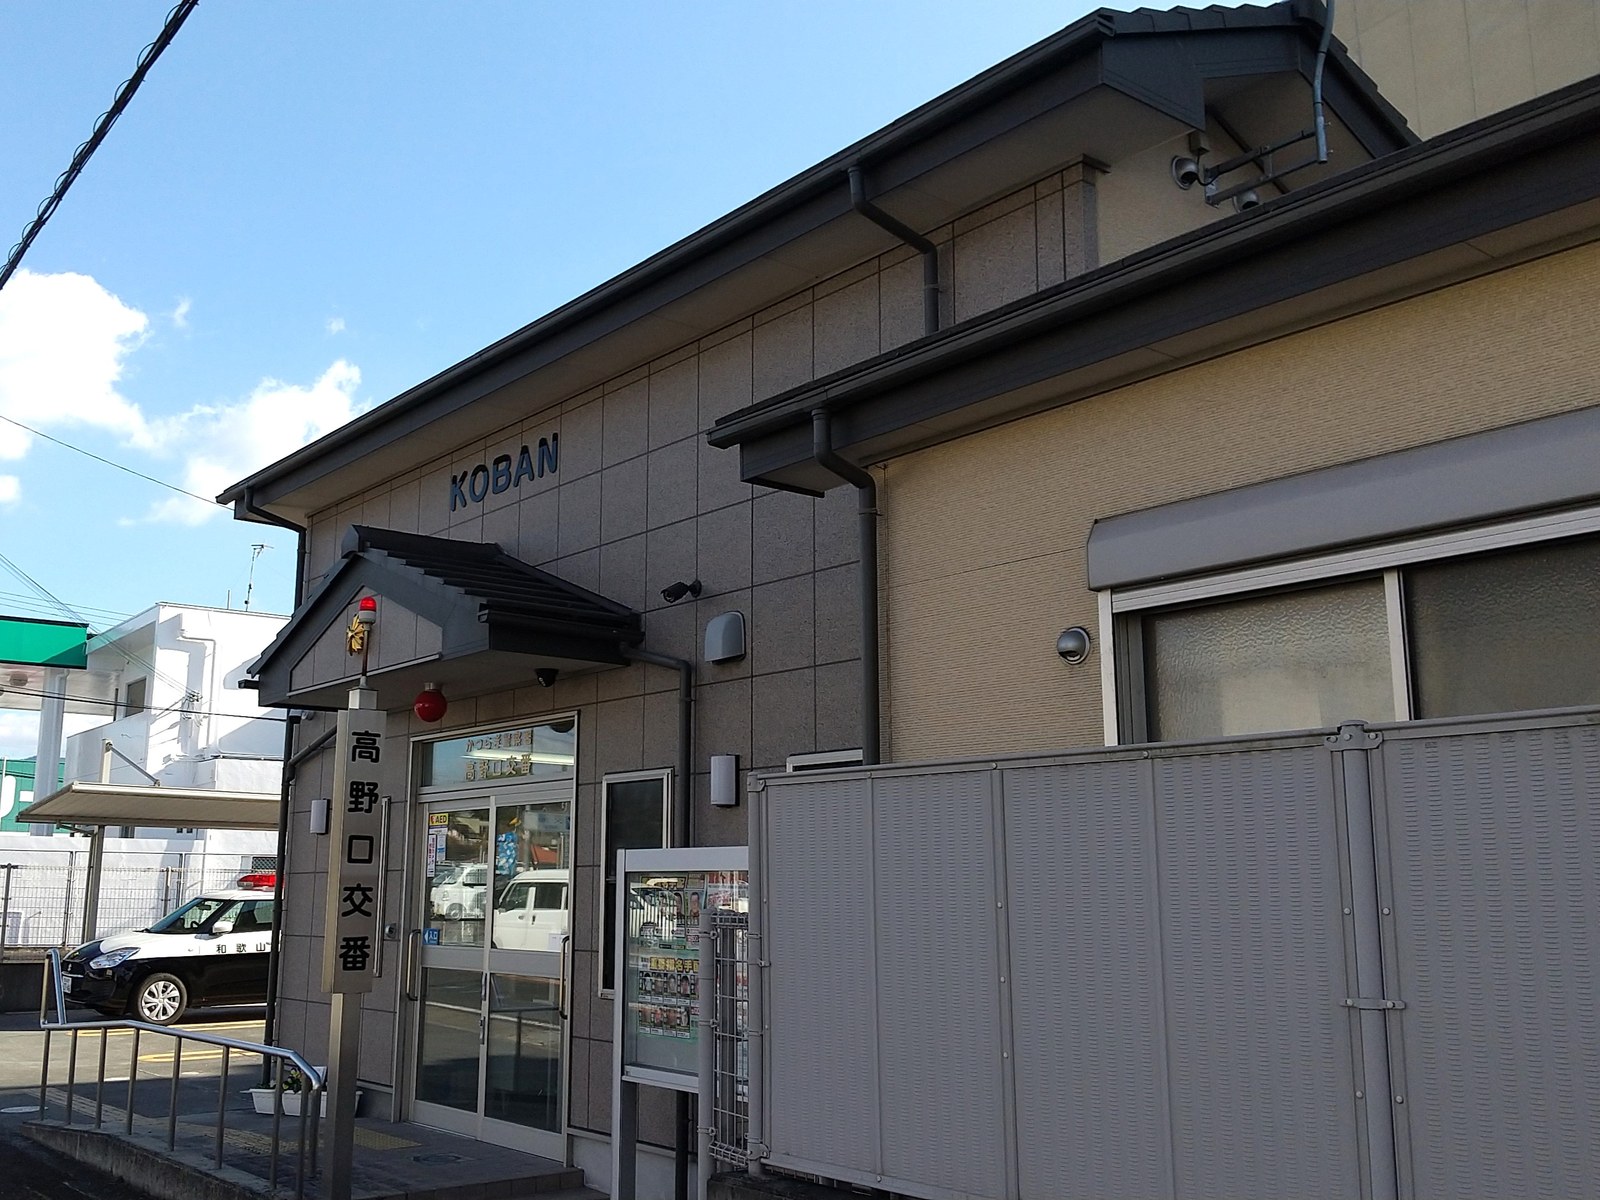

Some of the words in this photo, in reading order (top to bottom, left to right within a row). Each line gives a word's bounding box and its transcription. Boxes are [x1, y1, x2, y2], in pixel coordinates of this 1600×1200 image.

[450, 432, 559, 512] KOBAN
[465, 753, 532, 782] 高野口交番
[435, 815, 447, 824] AED
[339, 730, 381, 971] 高野口交番
[216, 942, 266, 954] 和歌山
